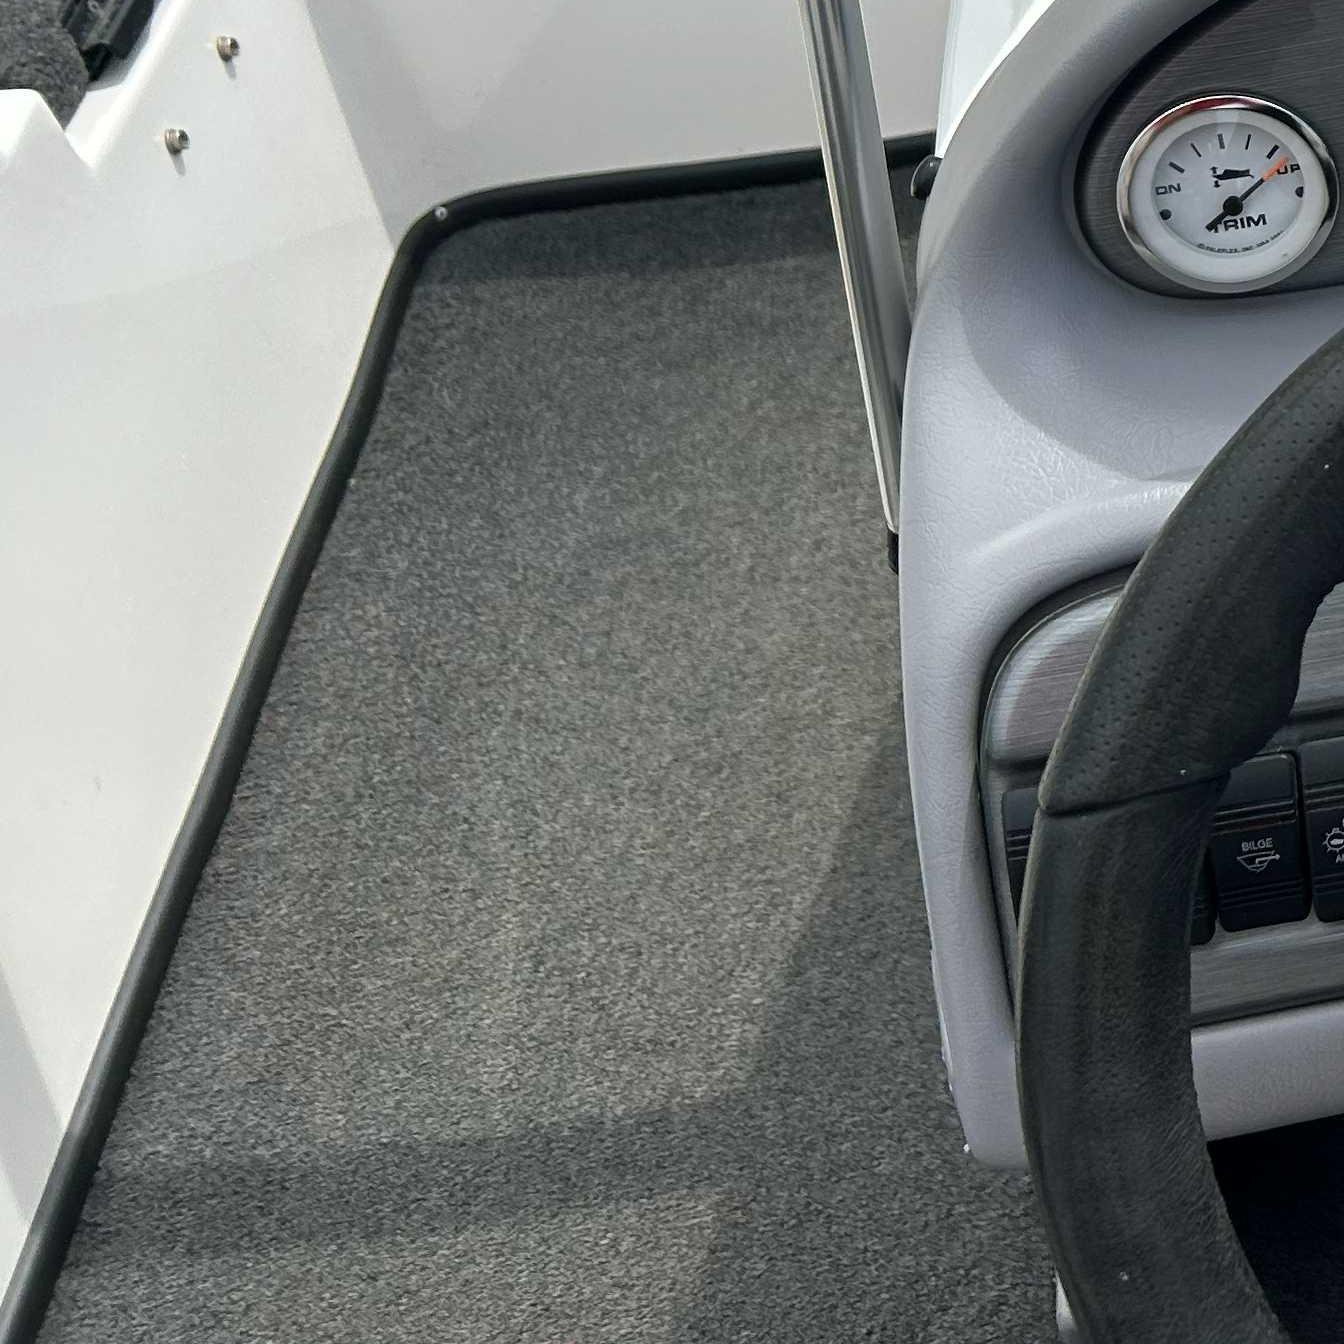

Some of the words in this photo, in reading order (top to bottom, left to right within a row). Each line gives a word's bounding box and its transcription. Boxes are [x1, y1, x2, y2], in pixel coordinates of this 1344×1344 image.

[1276, 163, 1301, 175] UP
[1154, 183, 1182, 196] DN
[1241, 837, 1273, 852] BILGE
